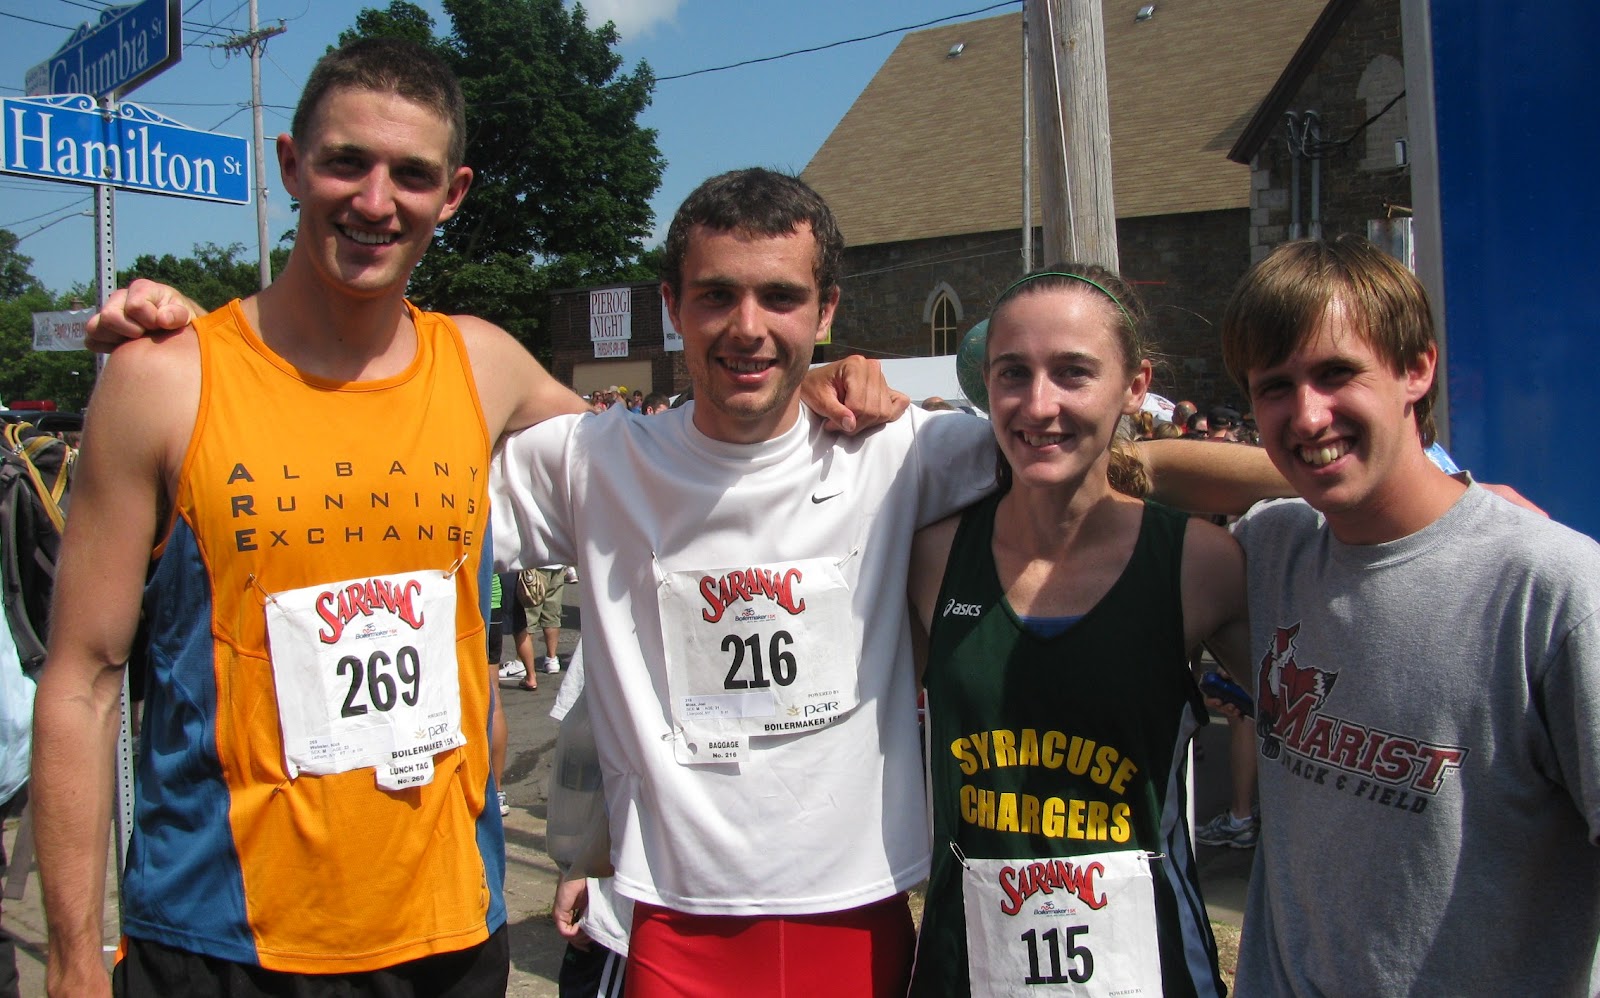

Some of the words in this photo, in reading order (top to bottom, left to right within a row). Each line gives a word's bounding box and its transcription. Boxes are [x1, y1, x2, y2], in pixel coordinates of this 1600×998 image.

[52, 18, 148, 97] Columbia
[152, 17, 163, 39] St
[10, 107, 218, 195] Hamilton
[223, 156, 243, 176] St
[591, 290, 630, 315] PIEROGI
[592, 314, 624, 338] NIGHT
[227, 460, 478, 485] ALBANY
[231, 492, 475, 518] RUNNING
[235, 525, 473, 552] EXCHANGE
[315, 578, 424, 644] SARANAC
[699, 567, 806, 623] SARANAC
[952, 603, 982, 616] asics
[336, 645, 420, 718] 269
[720, 630, 797, 690] 216
[709, 741, 739, 749] BAGGAGE
[764, 718, 825, 731] BOILERMAKER
[1271, 683, 1469, 795] MARIST
[390, 765, 413, 775] LUNCH
[416, 762, 428, 770] TAG
[391, 740, 443, 759] BOILERMAKER
[444, 737, 454, 746] 15K
[950, 728, 1138, 795] SYRACUSE
[960, 784, 1131, 843] CHARGERS
[1355, 780, 1428, 814] FIELD
[999, 859, 1107, 916] SARANAC
[1021, 925, 1094, 984] 115
